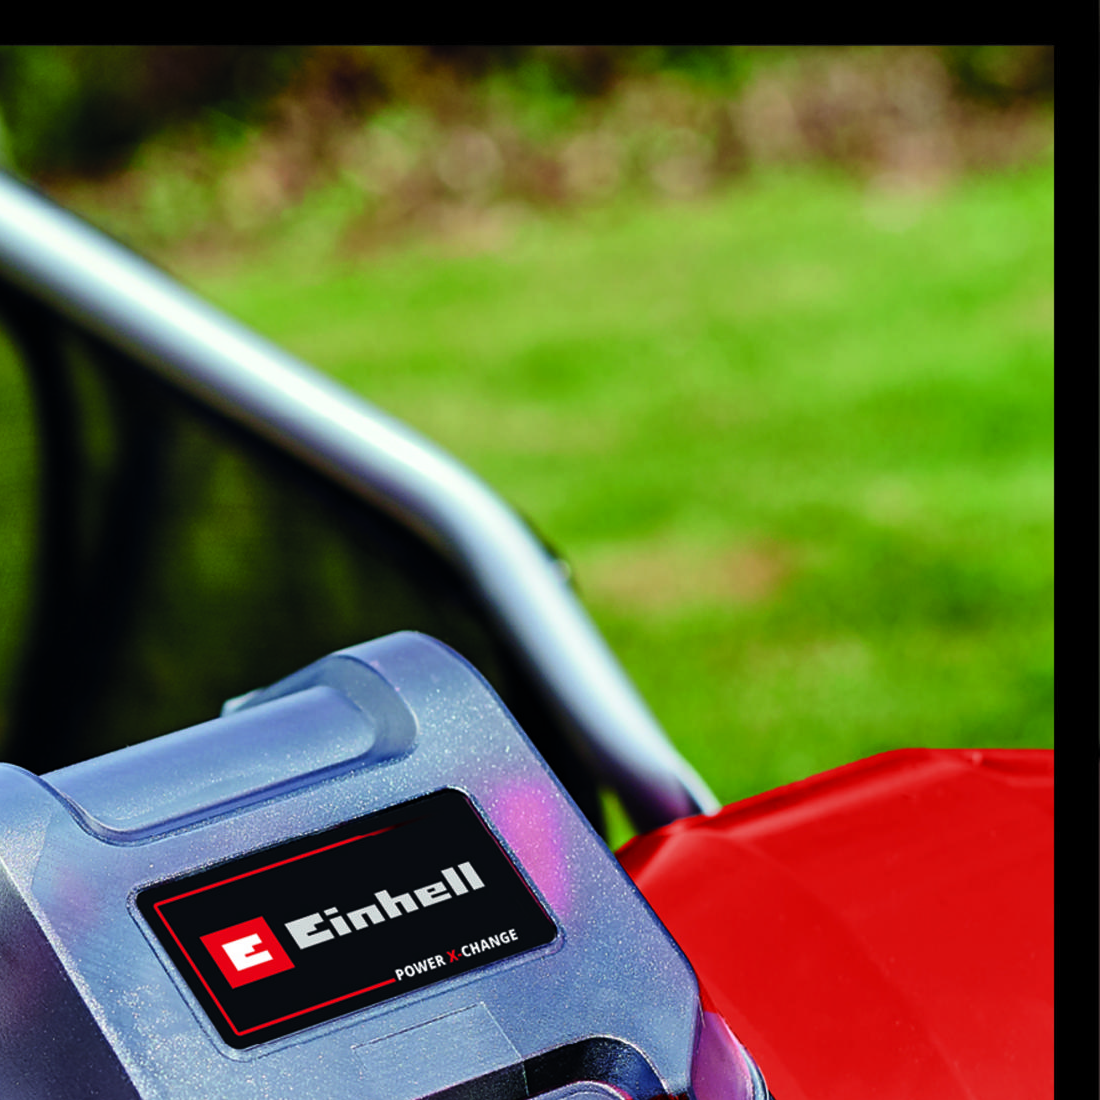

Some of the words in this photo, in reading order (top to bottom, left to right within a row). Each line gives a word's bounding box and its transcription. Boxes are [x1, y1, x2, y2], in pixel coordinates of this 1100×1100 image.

[284, 861, 486, 949] Einhell
[394, 953, 447, 981] POWER
[447, 928, 519, 963] X-CHANGE
